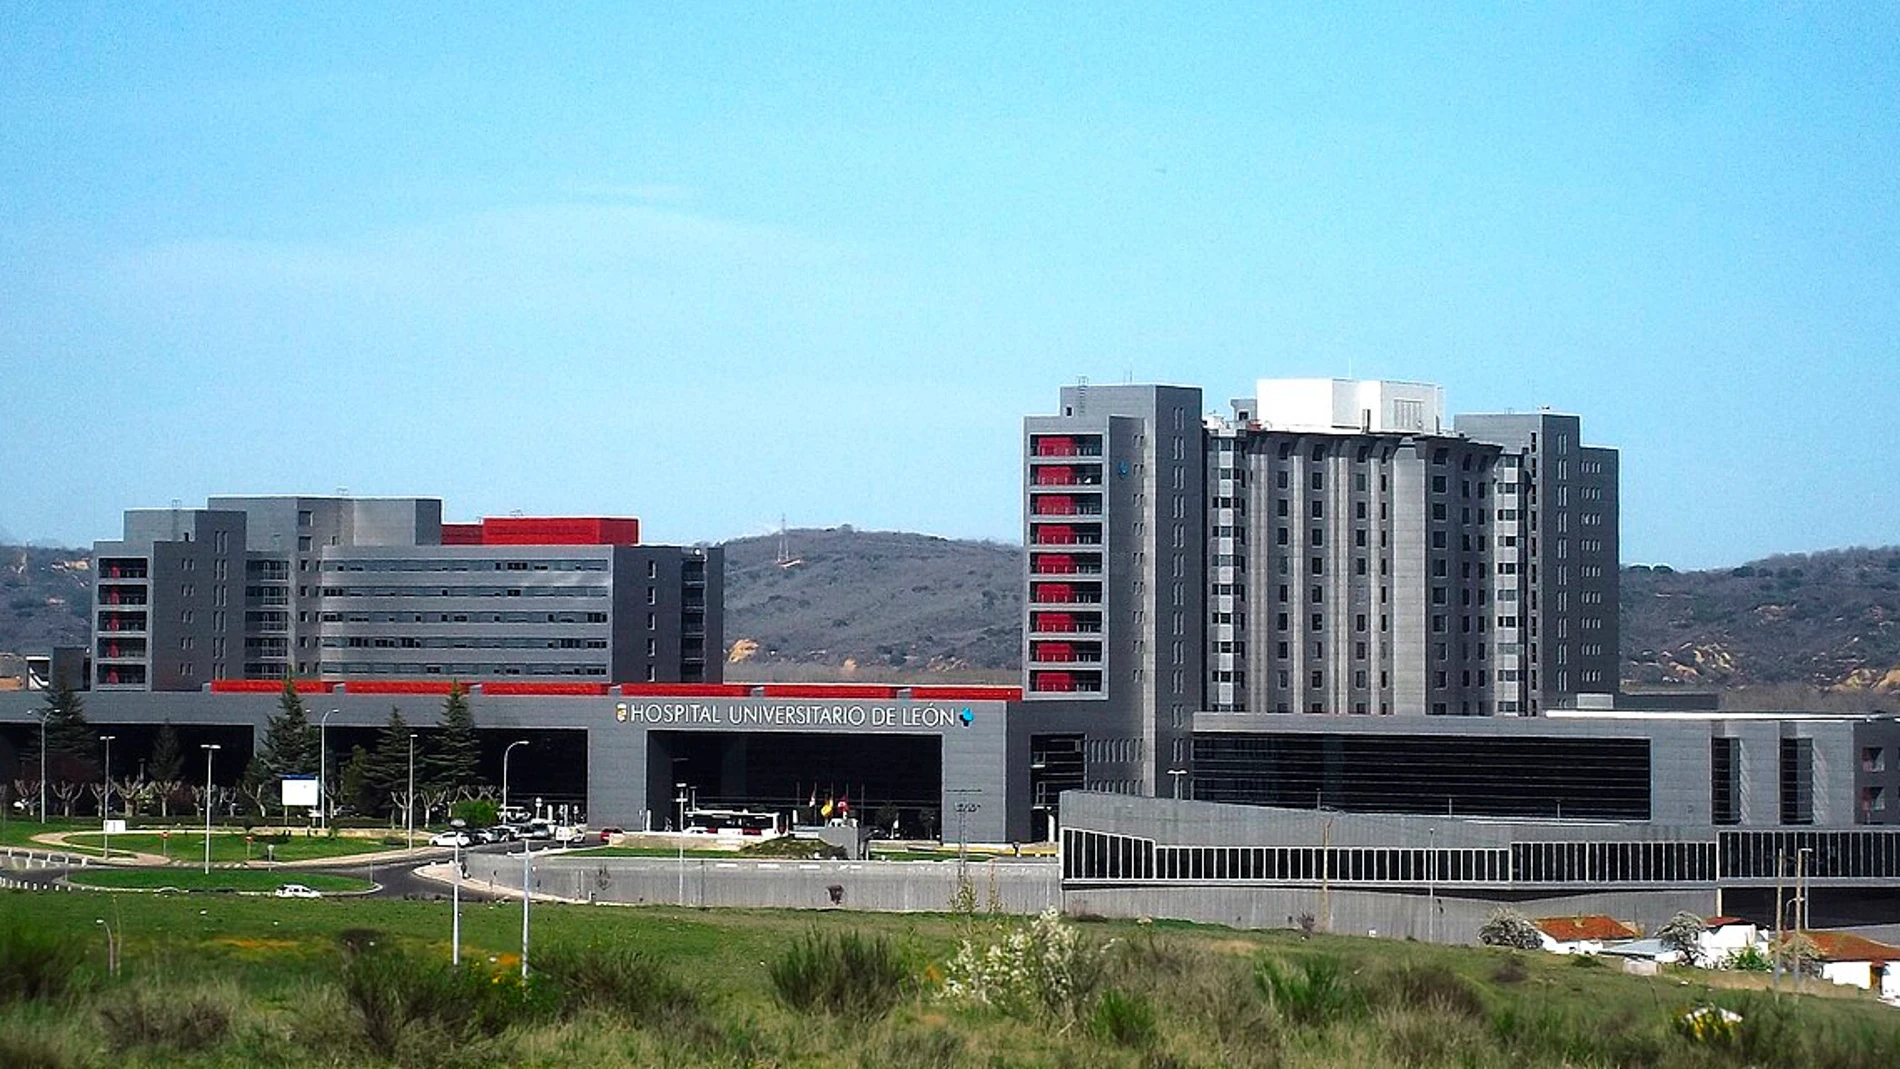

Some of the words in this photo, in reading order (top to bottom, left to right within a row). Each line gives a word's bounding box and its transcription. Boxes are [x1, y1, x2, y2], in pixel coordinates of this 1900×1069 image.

[630, 703, 721, 724] HOSPITAL
[729, 704, 866, 726] UNIVERSITARIO
[872, 707, 896, 726] DE
[902, 702, 955, 727] LEÓN
